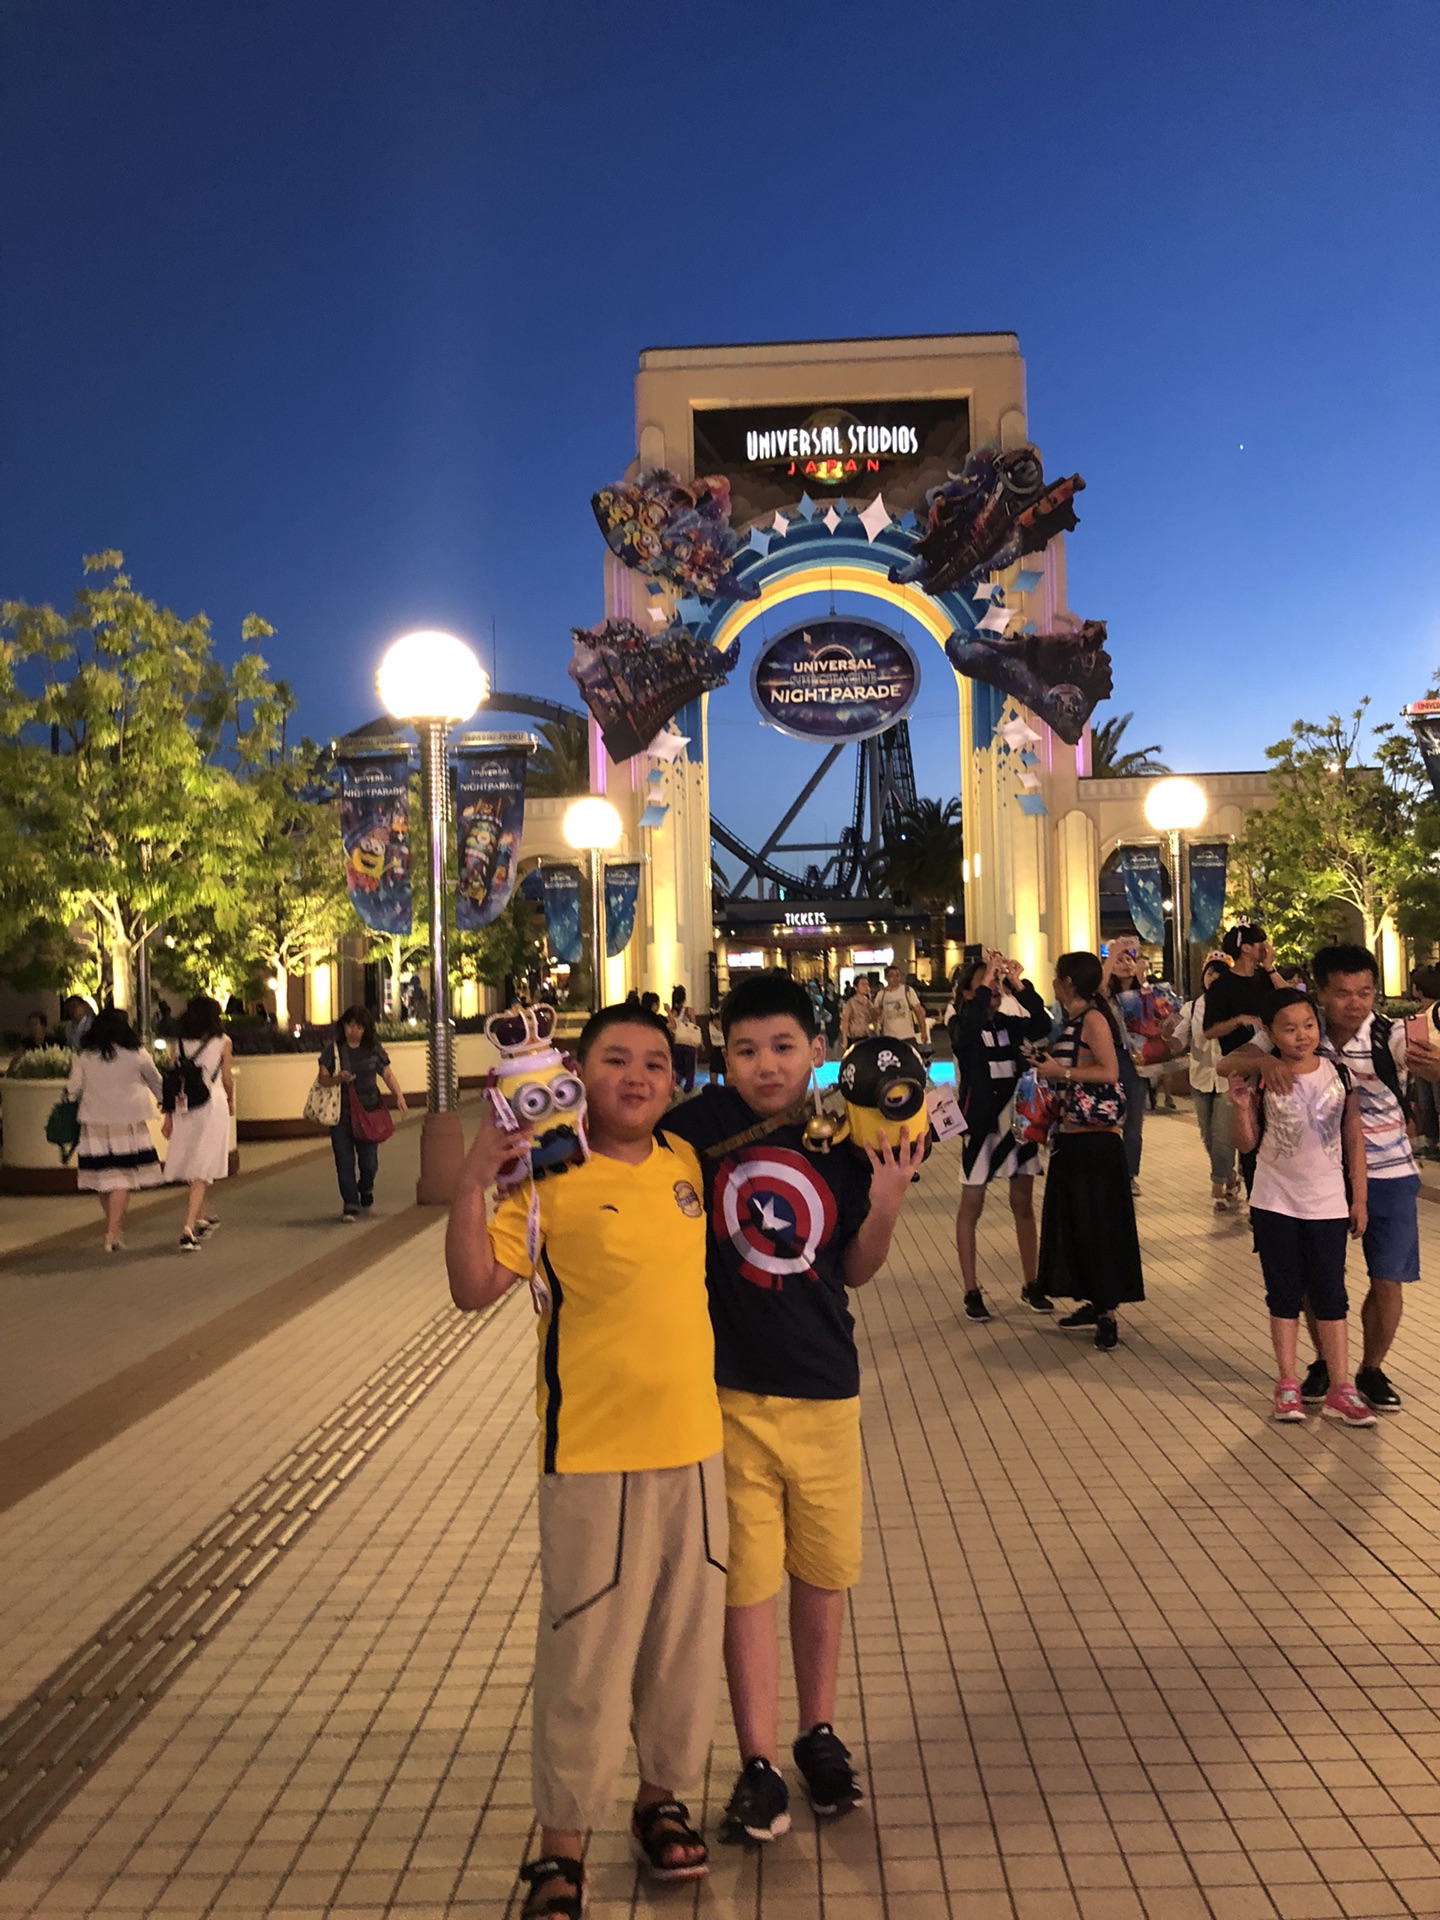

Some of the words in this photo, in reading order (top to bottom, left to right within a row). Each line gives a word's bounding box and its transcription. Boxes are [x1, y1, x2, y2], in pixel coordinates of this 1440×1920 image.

[746, 426, 843, 461] UNIVERSAL
[847, 424, 919, 454] STUDIOS
[786, 459, 880, 476] JAPAN
[793, 658, 876, 673] UNIVERSAL
[784, 912, 827, 926] TICKETS
